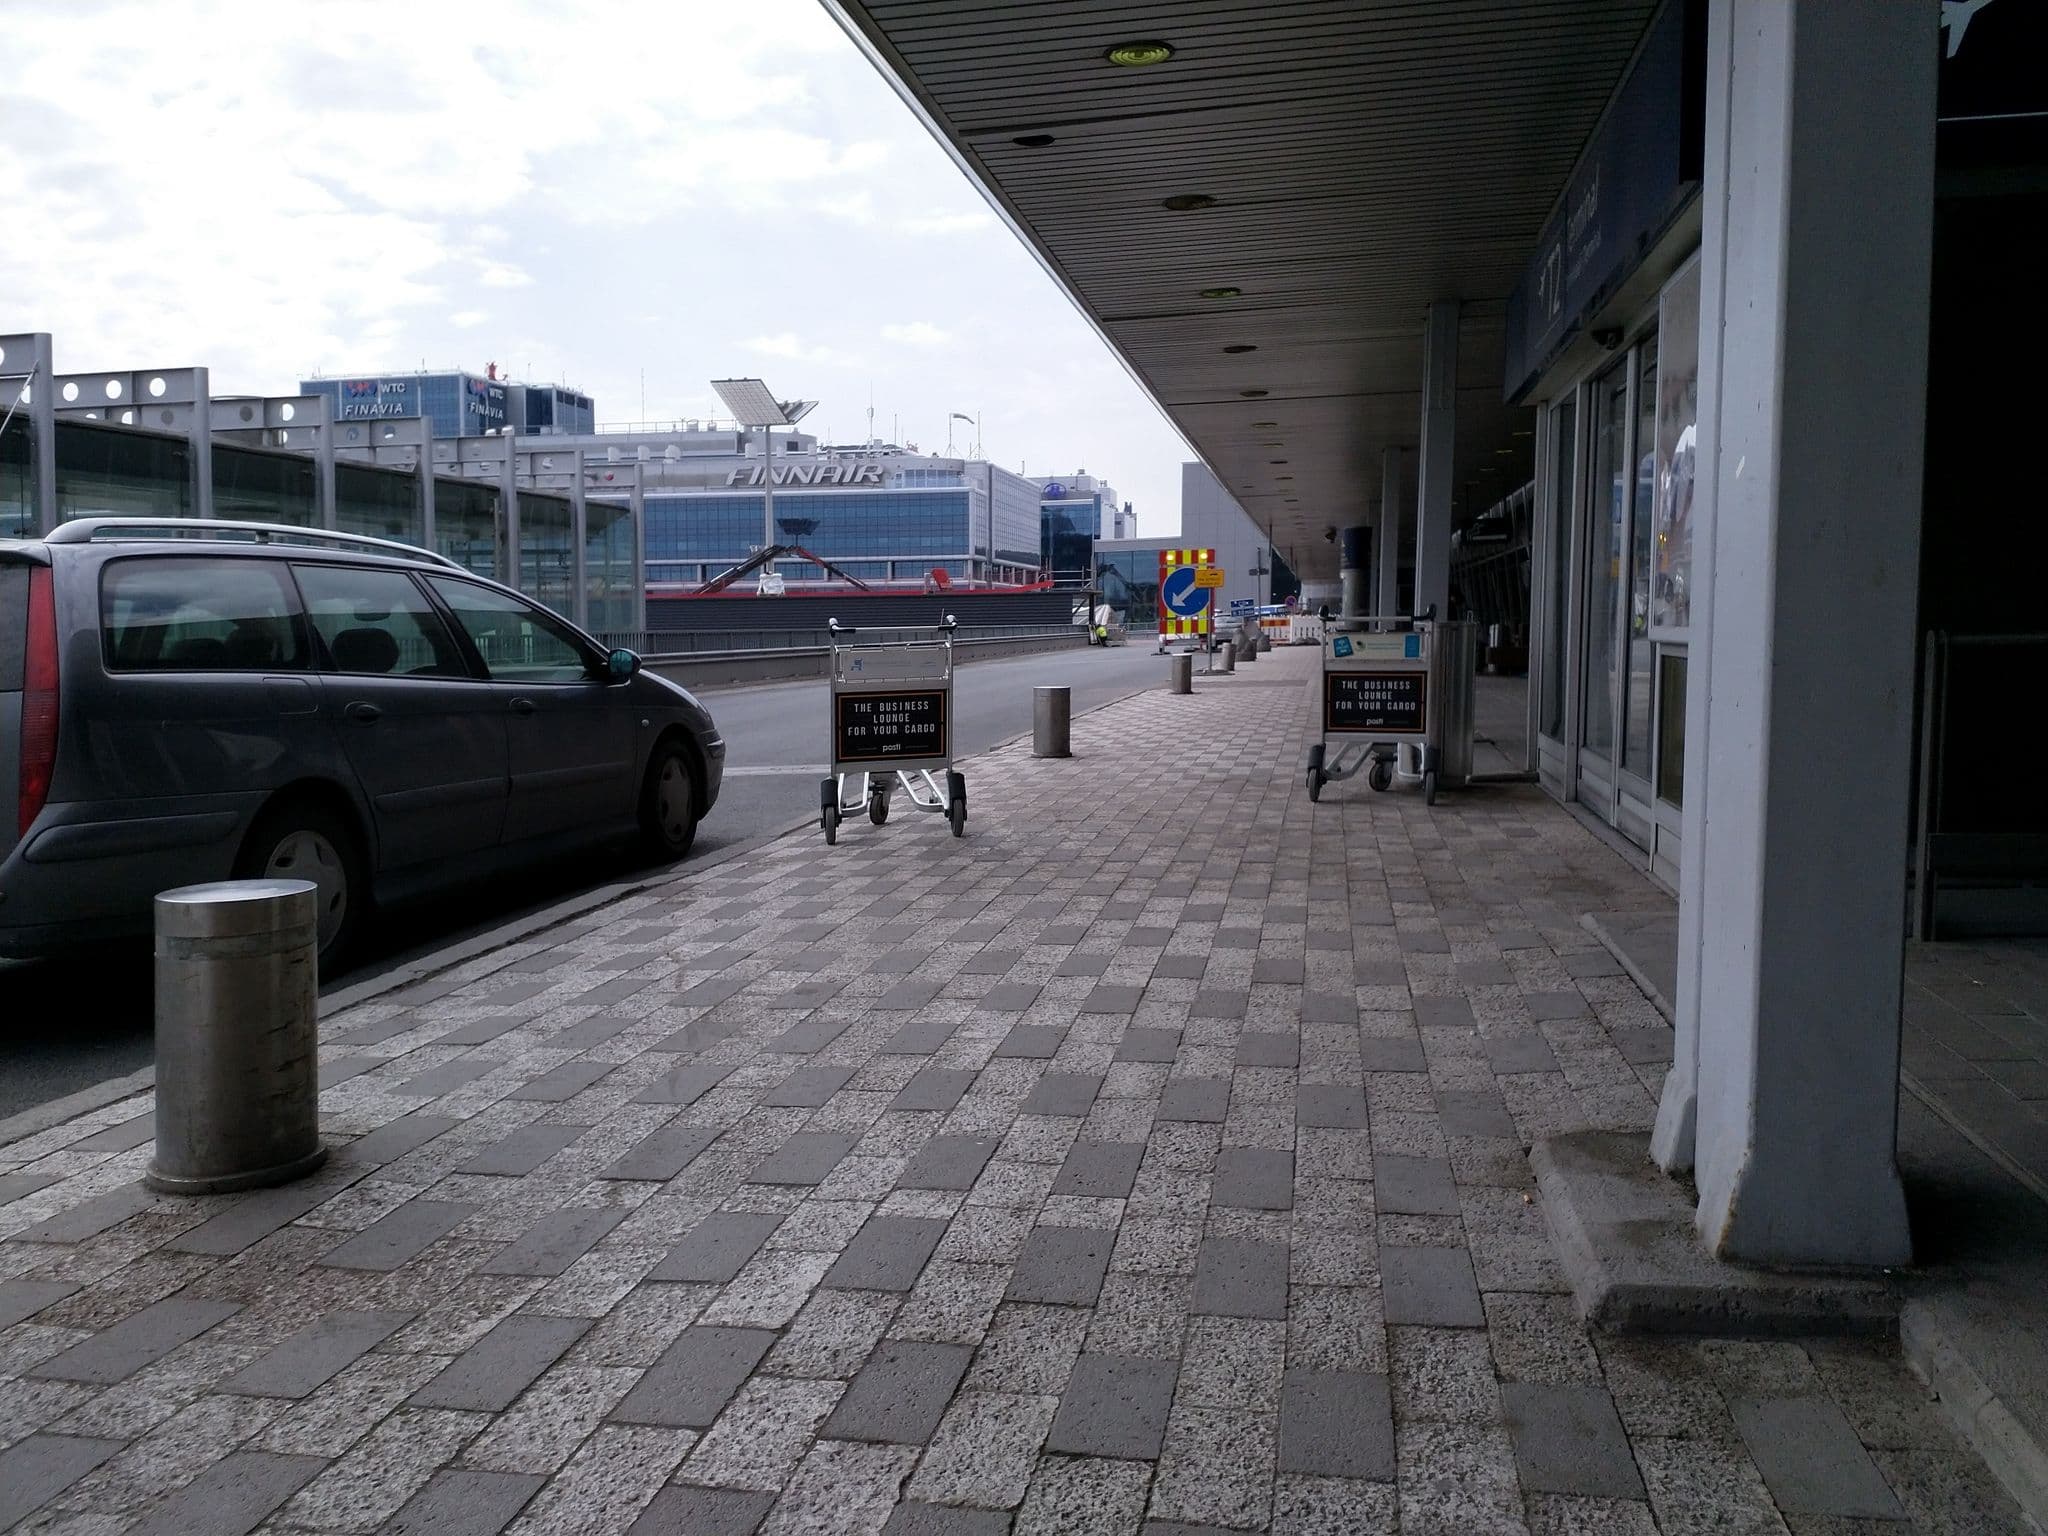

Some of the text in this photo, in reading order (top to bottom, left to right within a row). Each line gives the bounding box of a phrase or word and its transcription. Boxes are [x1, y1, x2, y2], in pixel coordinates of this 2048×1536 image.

[381, 382, 405, 393] WTC
[489, 387, 504, 400] WTC
[345, 402, 404, 416] FINAVIA
[470, 402, 504, 420] FINAVIA
[726, 463, 884, 486] FINNAIR
[1342, 681, 1411, 690] THE BUSINESS
[1358, 691, 1393, 700] LOUNGE
[854, 701, 929, 712] THE BUSINESS
[1335, 701, 1416, 711] FOR YOUR CARGO
[873, 713, 910, 723] LOUNGE
[848, 724, 935, 736] FOR YOUR CARGO
